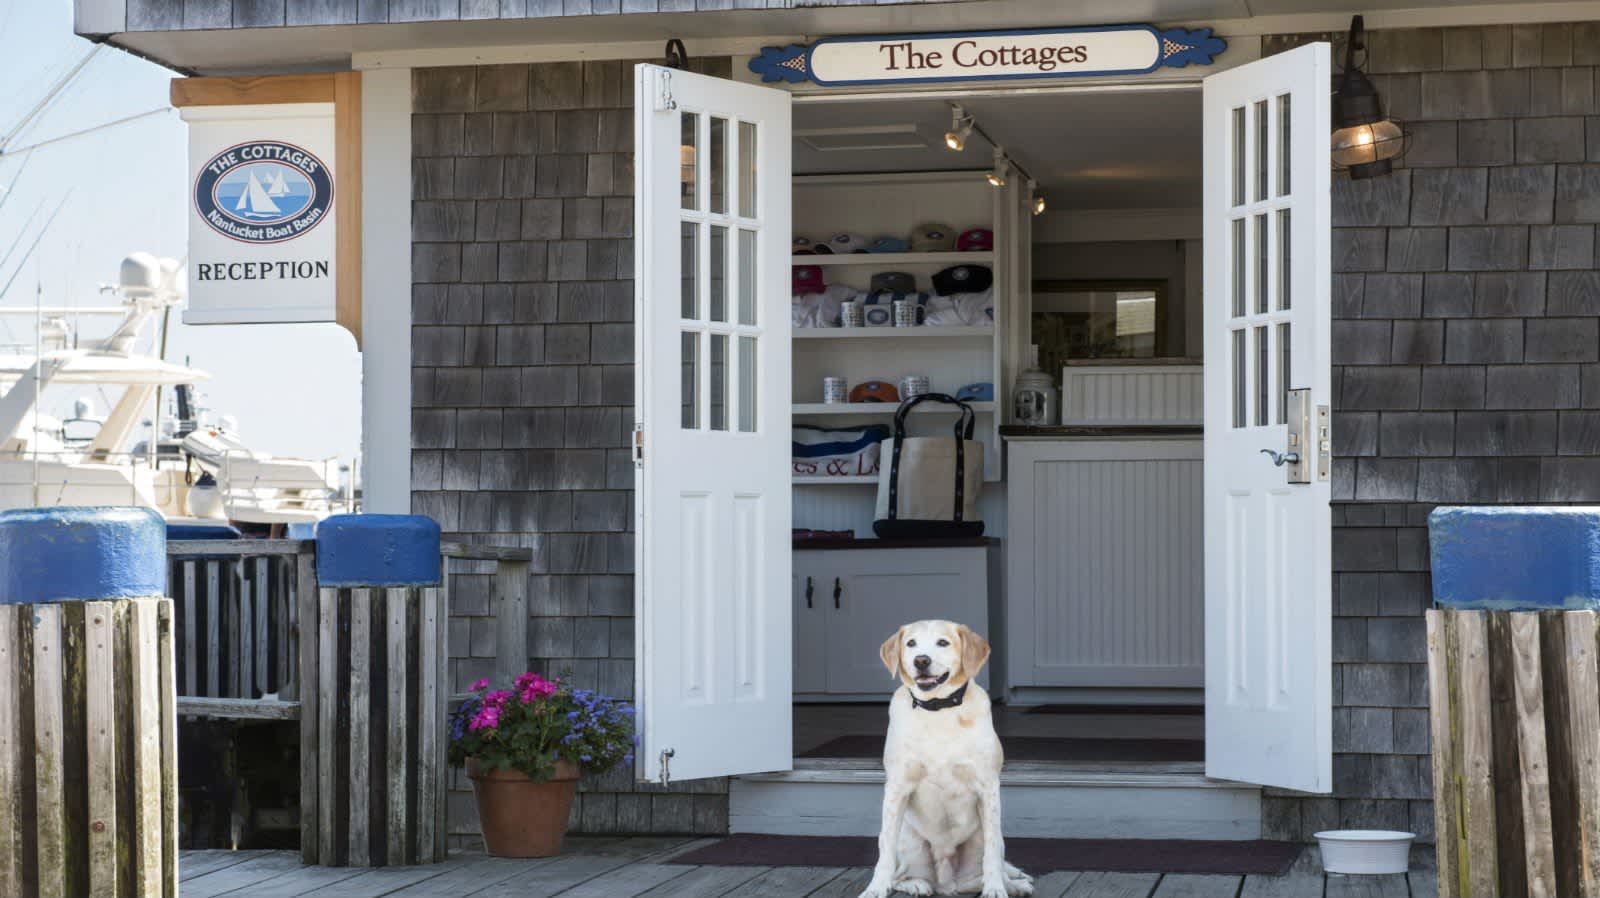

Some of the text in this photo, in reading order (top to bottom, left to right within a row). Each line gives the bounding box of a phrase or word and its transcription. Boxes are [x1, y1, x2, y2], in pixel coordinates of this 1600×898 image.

[879, 40, 1088, 71] The Cottages
[208, 145, 319, 174] THE COTTAGES
[207, 207, 322, 240] Nantucket Boat Basin
[198, 260, 329, 281] RECEPTION
[826, 458, 849, 476] &
